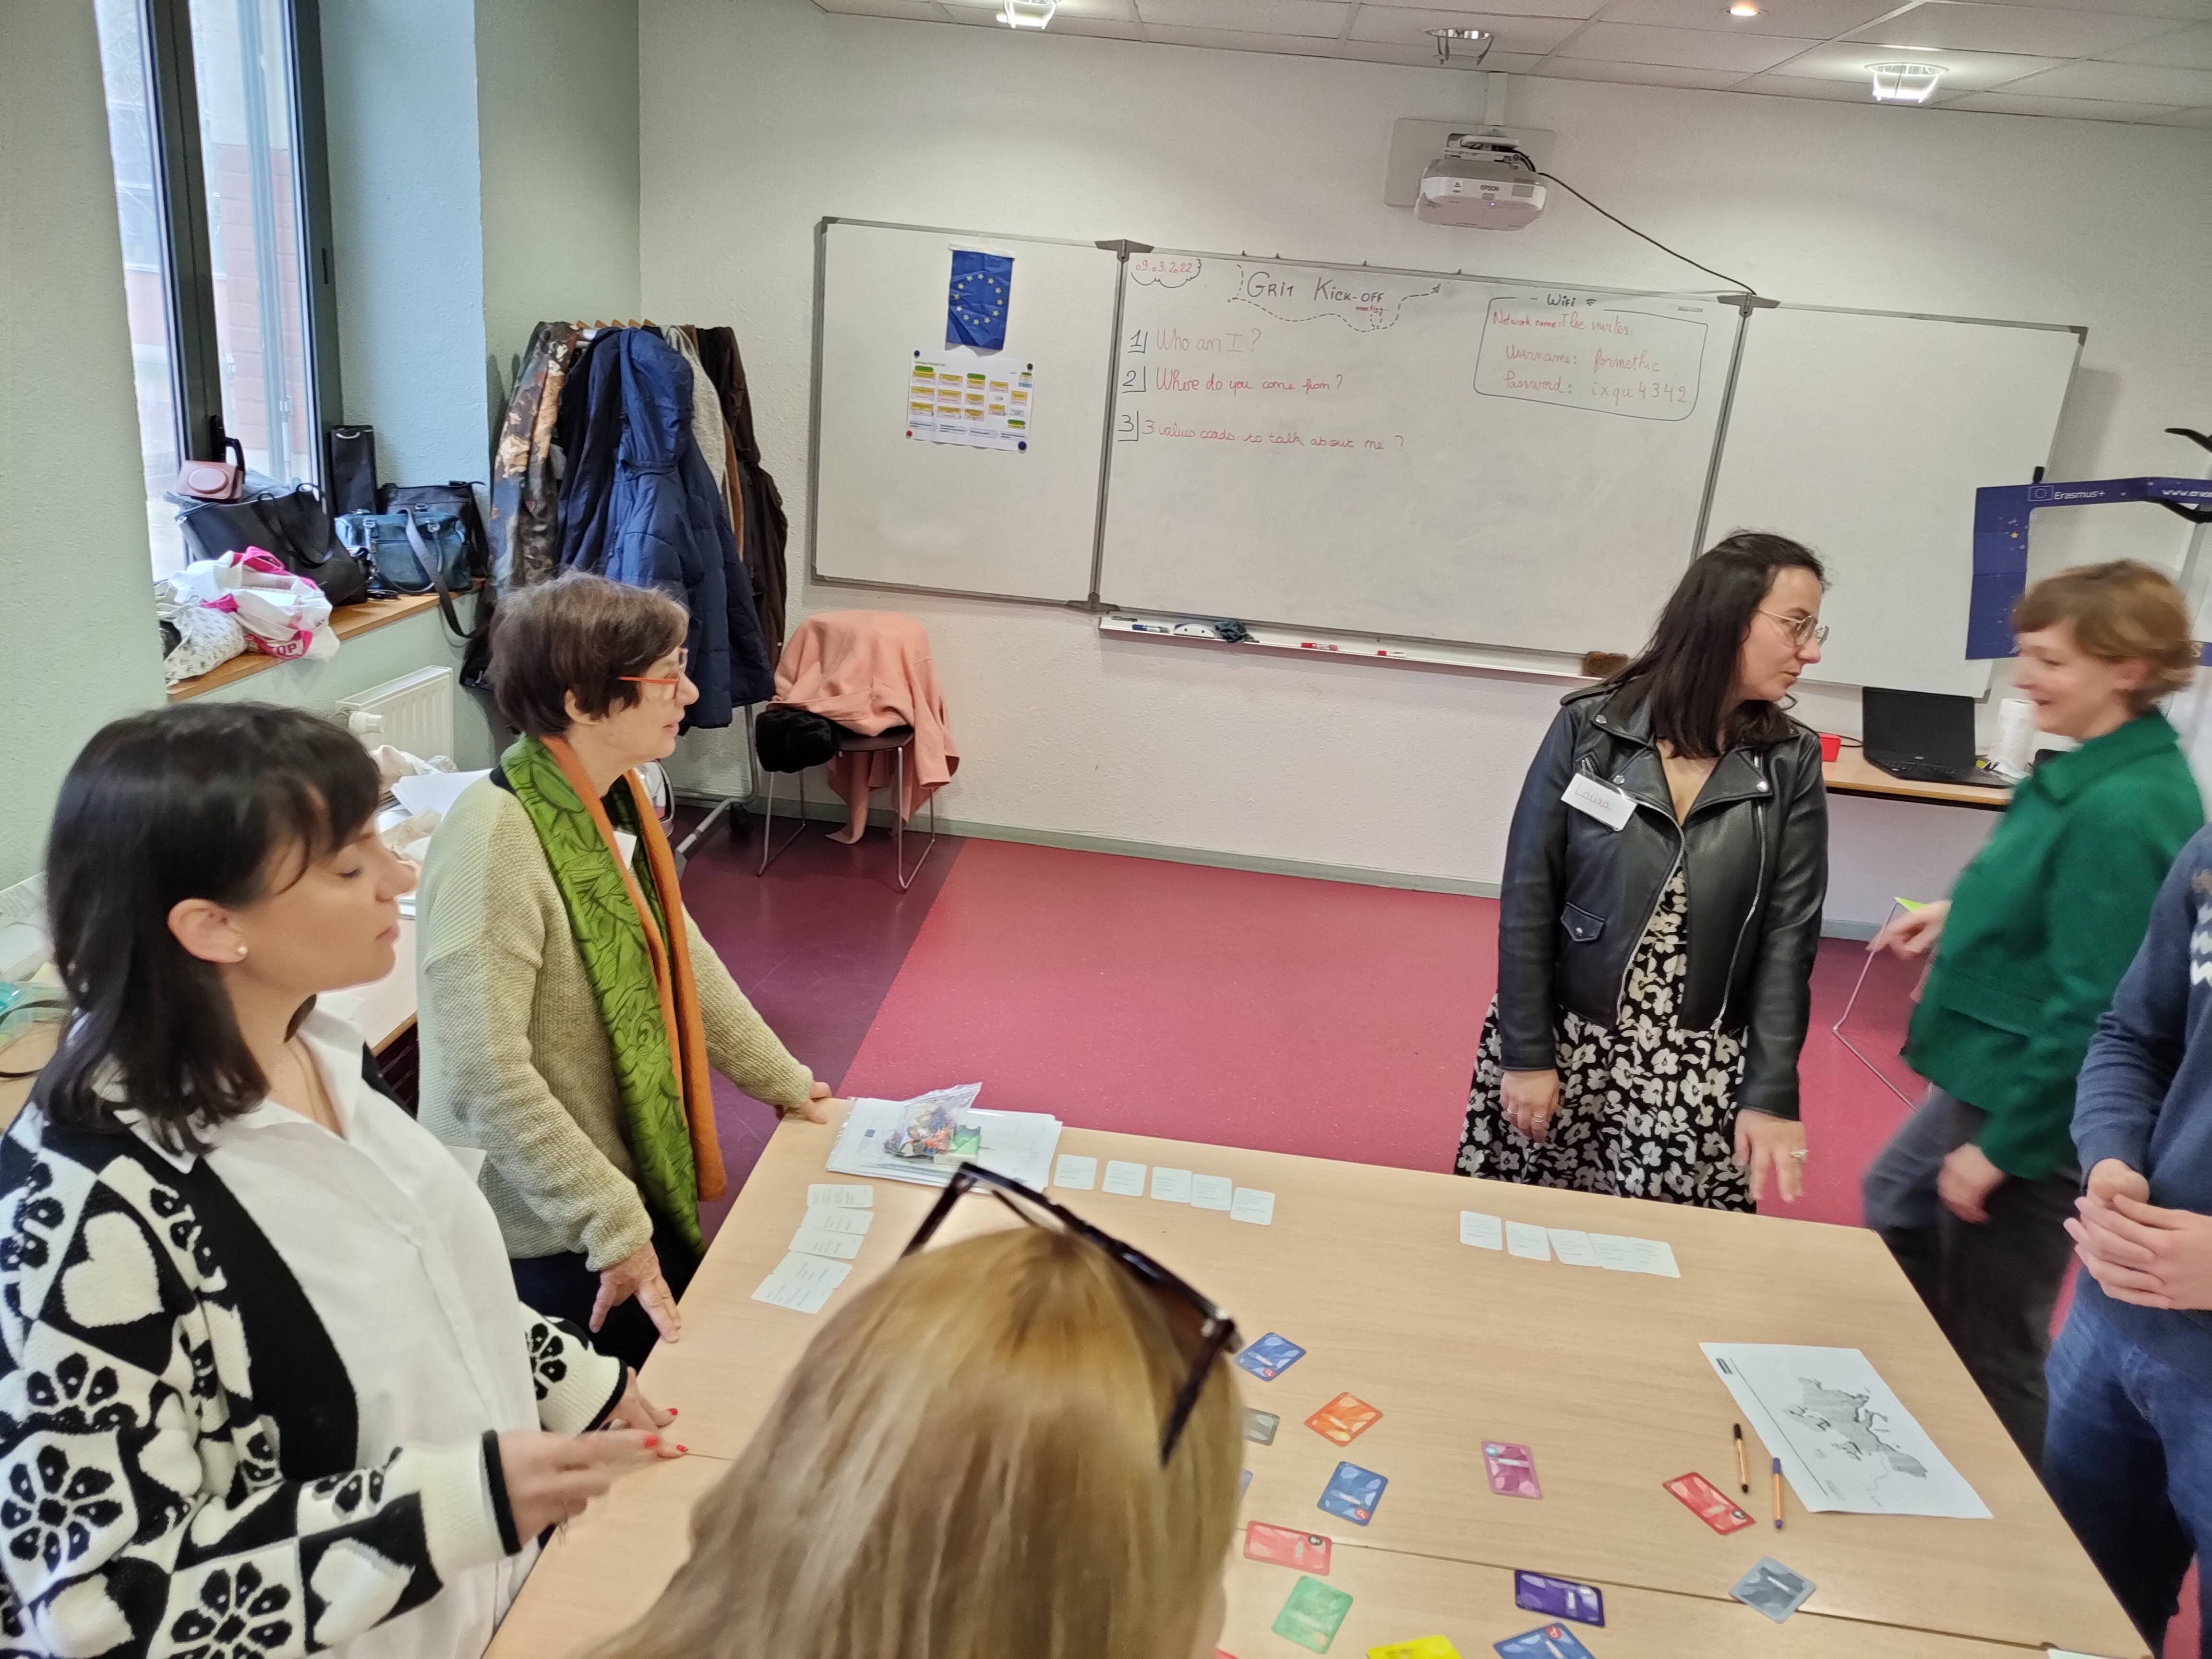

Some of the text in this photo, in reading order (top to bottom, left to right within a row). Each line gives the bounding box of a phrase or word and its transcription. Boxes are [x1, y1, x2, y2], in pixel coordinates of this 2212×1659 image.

[1493, 311, 1532, 326] Network
[1156, 328, 1190, 351] Who
[1196, 337, 1221, 352] am
[1205, 373, 1223, 391] do
[1229, 380, 1253, 397] you
[1262, 381, 1295, 390] come
[1158, 423, 1195, 438] values
[1244, 432, 1263, 443] to
[1269, 432, 1305, 446] talk
[1310, 437, 1355, 448] about
[1364, 440, 1384, 450] me
[2054, 490, 2106, 500] Erasmus+
